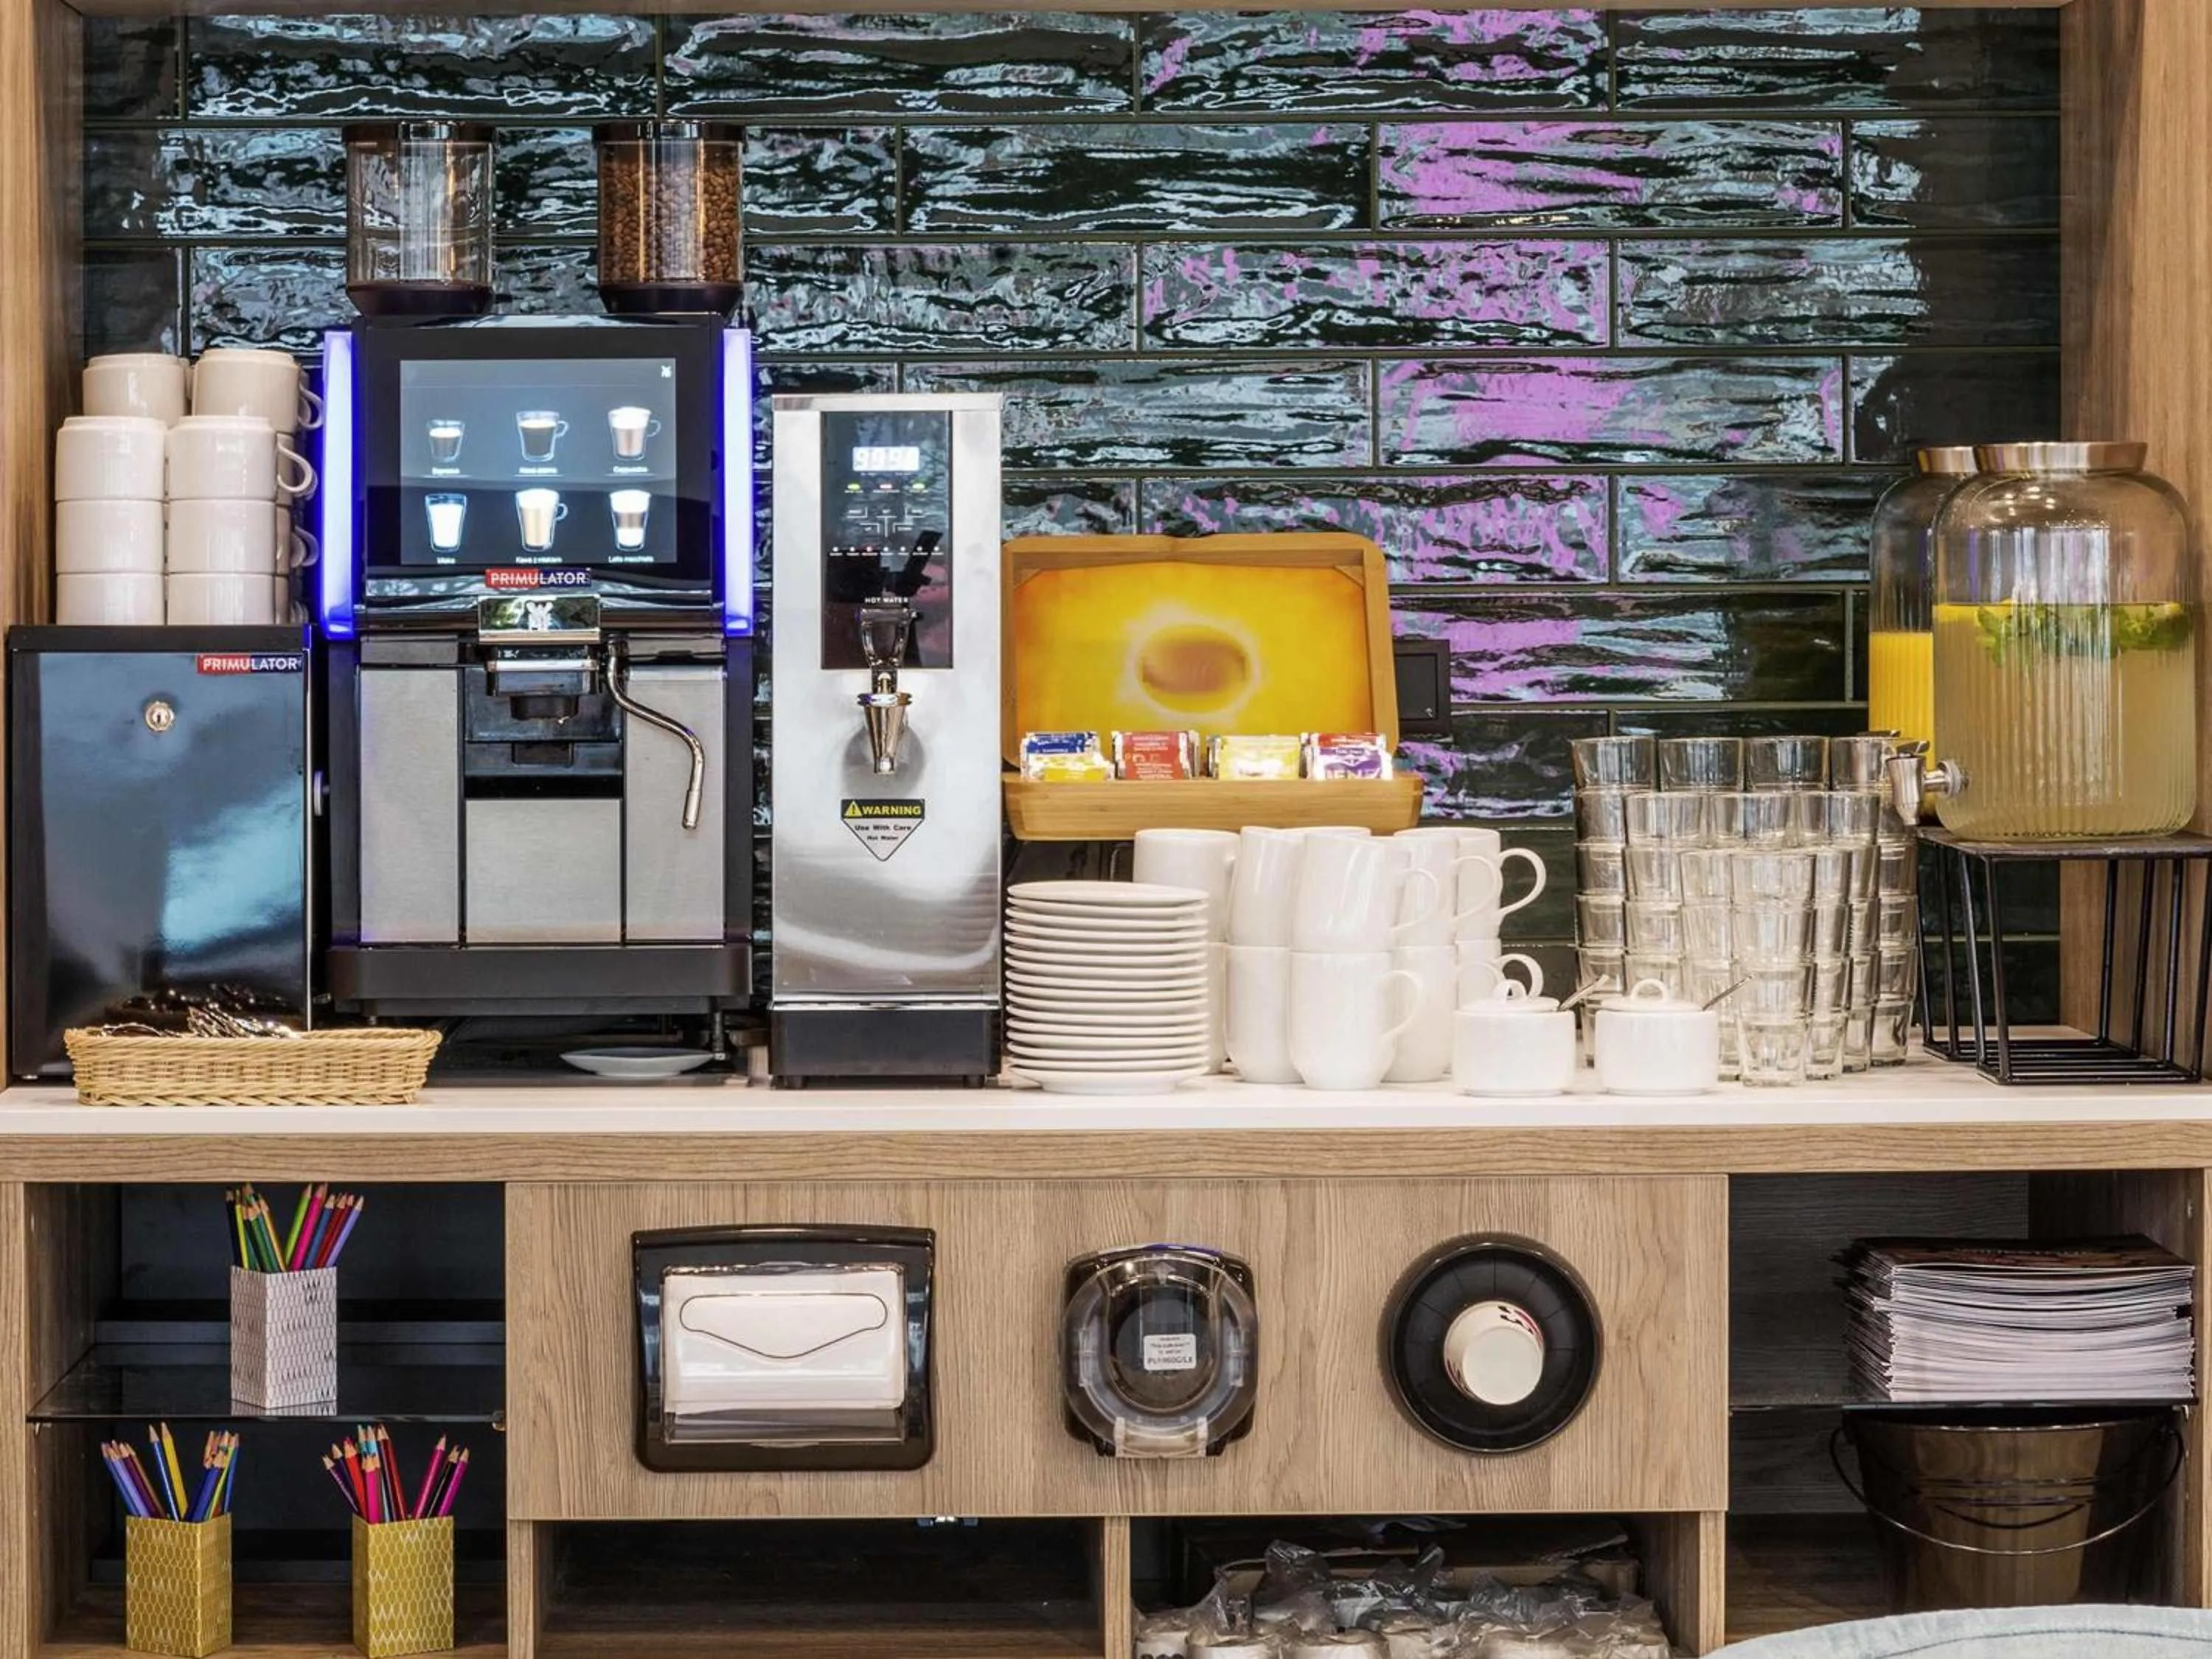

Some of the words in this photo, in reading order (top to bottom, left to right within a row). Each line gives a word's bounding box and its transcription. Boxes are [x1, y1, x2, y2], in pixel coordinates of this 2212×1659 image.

[490, 571, 586, 585] PRIMULATOR
[203, 657, 297, 670] PRIMULATOR
[862, 805, 921, 815] WARNING
